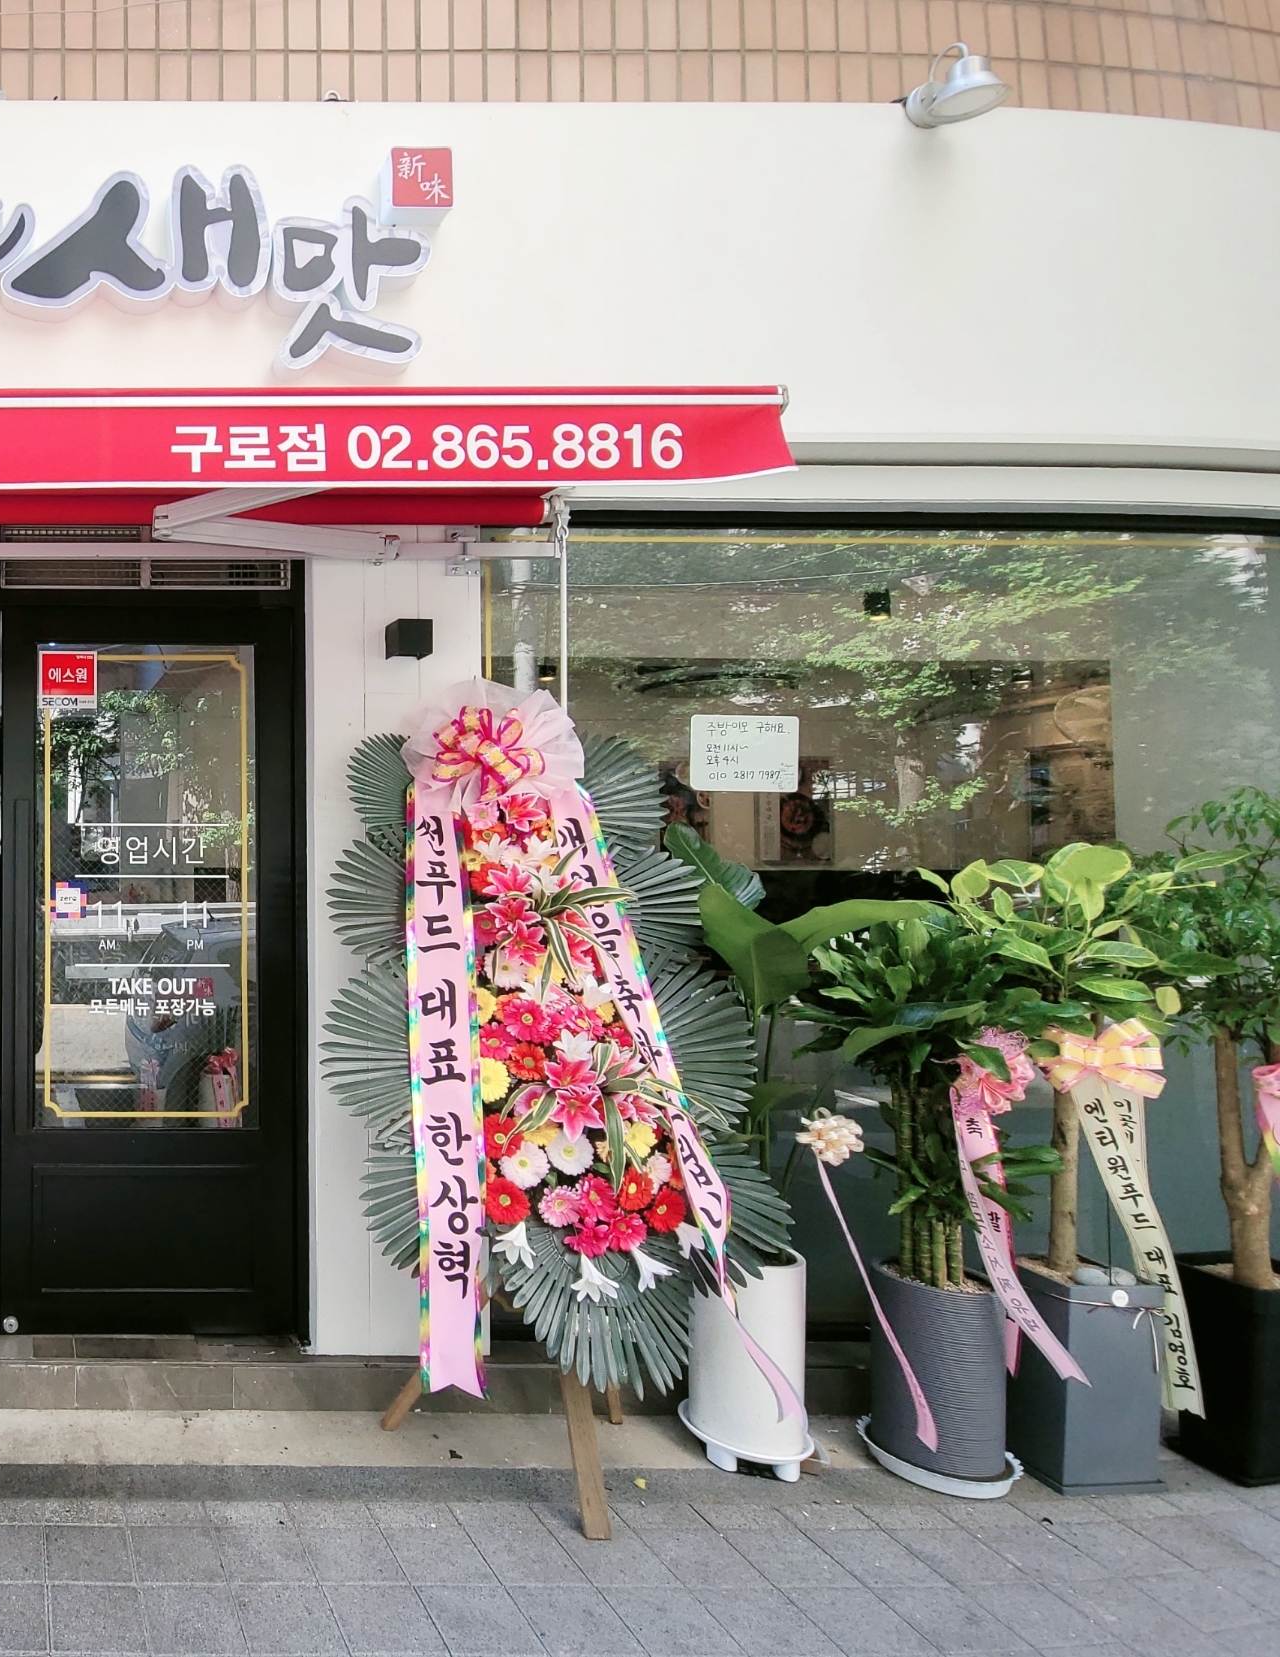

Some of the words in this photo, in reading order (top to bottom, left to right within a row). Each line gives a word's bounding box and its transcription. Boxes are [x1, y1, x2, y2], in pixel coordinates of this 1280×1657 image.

[396, 152, 450, 204] 新味
[10, 173, 422, 359] 새맛
[171, 424, 327, 473] 구로점
[347, 424, 684, 472] 02.865.8816
[48, 667, 88, 684] 에스원
[42, 697, 78, 707] SECOM
[706, 721, 749, 737] 주방이모
[705, 743, 721, 753] 오전
[705, 755, 720, 767] 오후
[722, 755, 739, 766] 4시
[708, 772, 727, 781] 010
[733, 770, 755, 780] 2817
[94, 835, 207, 866] 영업시간
[91, 900, 123, 929] 11
[178, 900, 208, 929] 11
[98, 939, 116, 950] AM
[186, 939, 204, 950] PM
[108, 977, 153, 995] TAKE
[157, 977, 197, 995] OUT
[88, 998, 150, 1016] 모든메뉴
[154, 998, 217, 1016] 포장가능
[418, 977, 467, 1085] 대표
[425, 1111, 479, 1300] 한상혁
[1144, 1246, 1178, 1296] 대표
